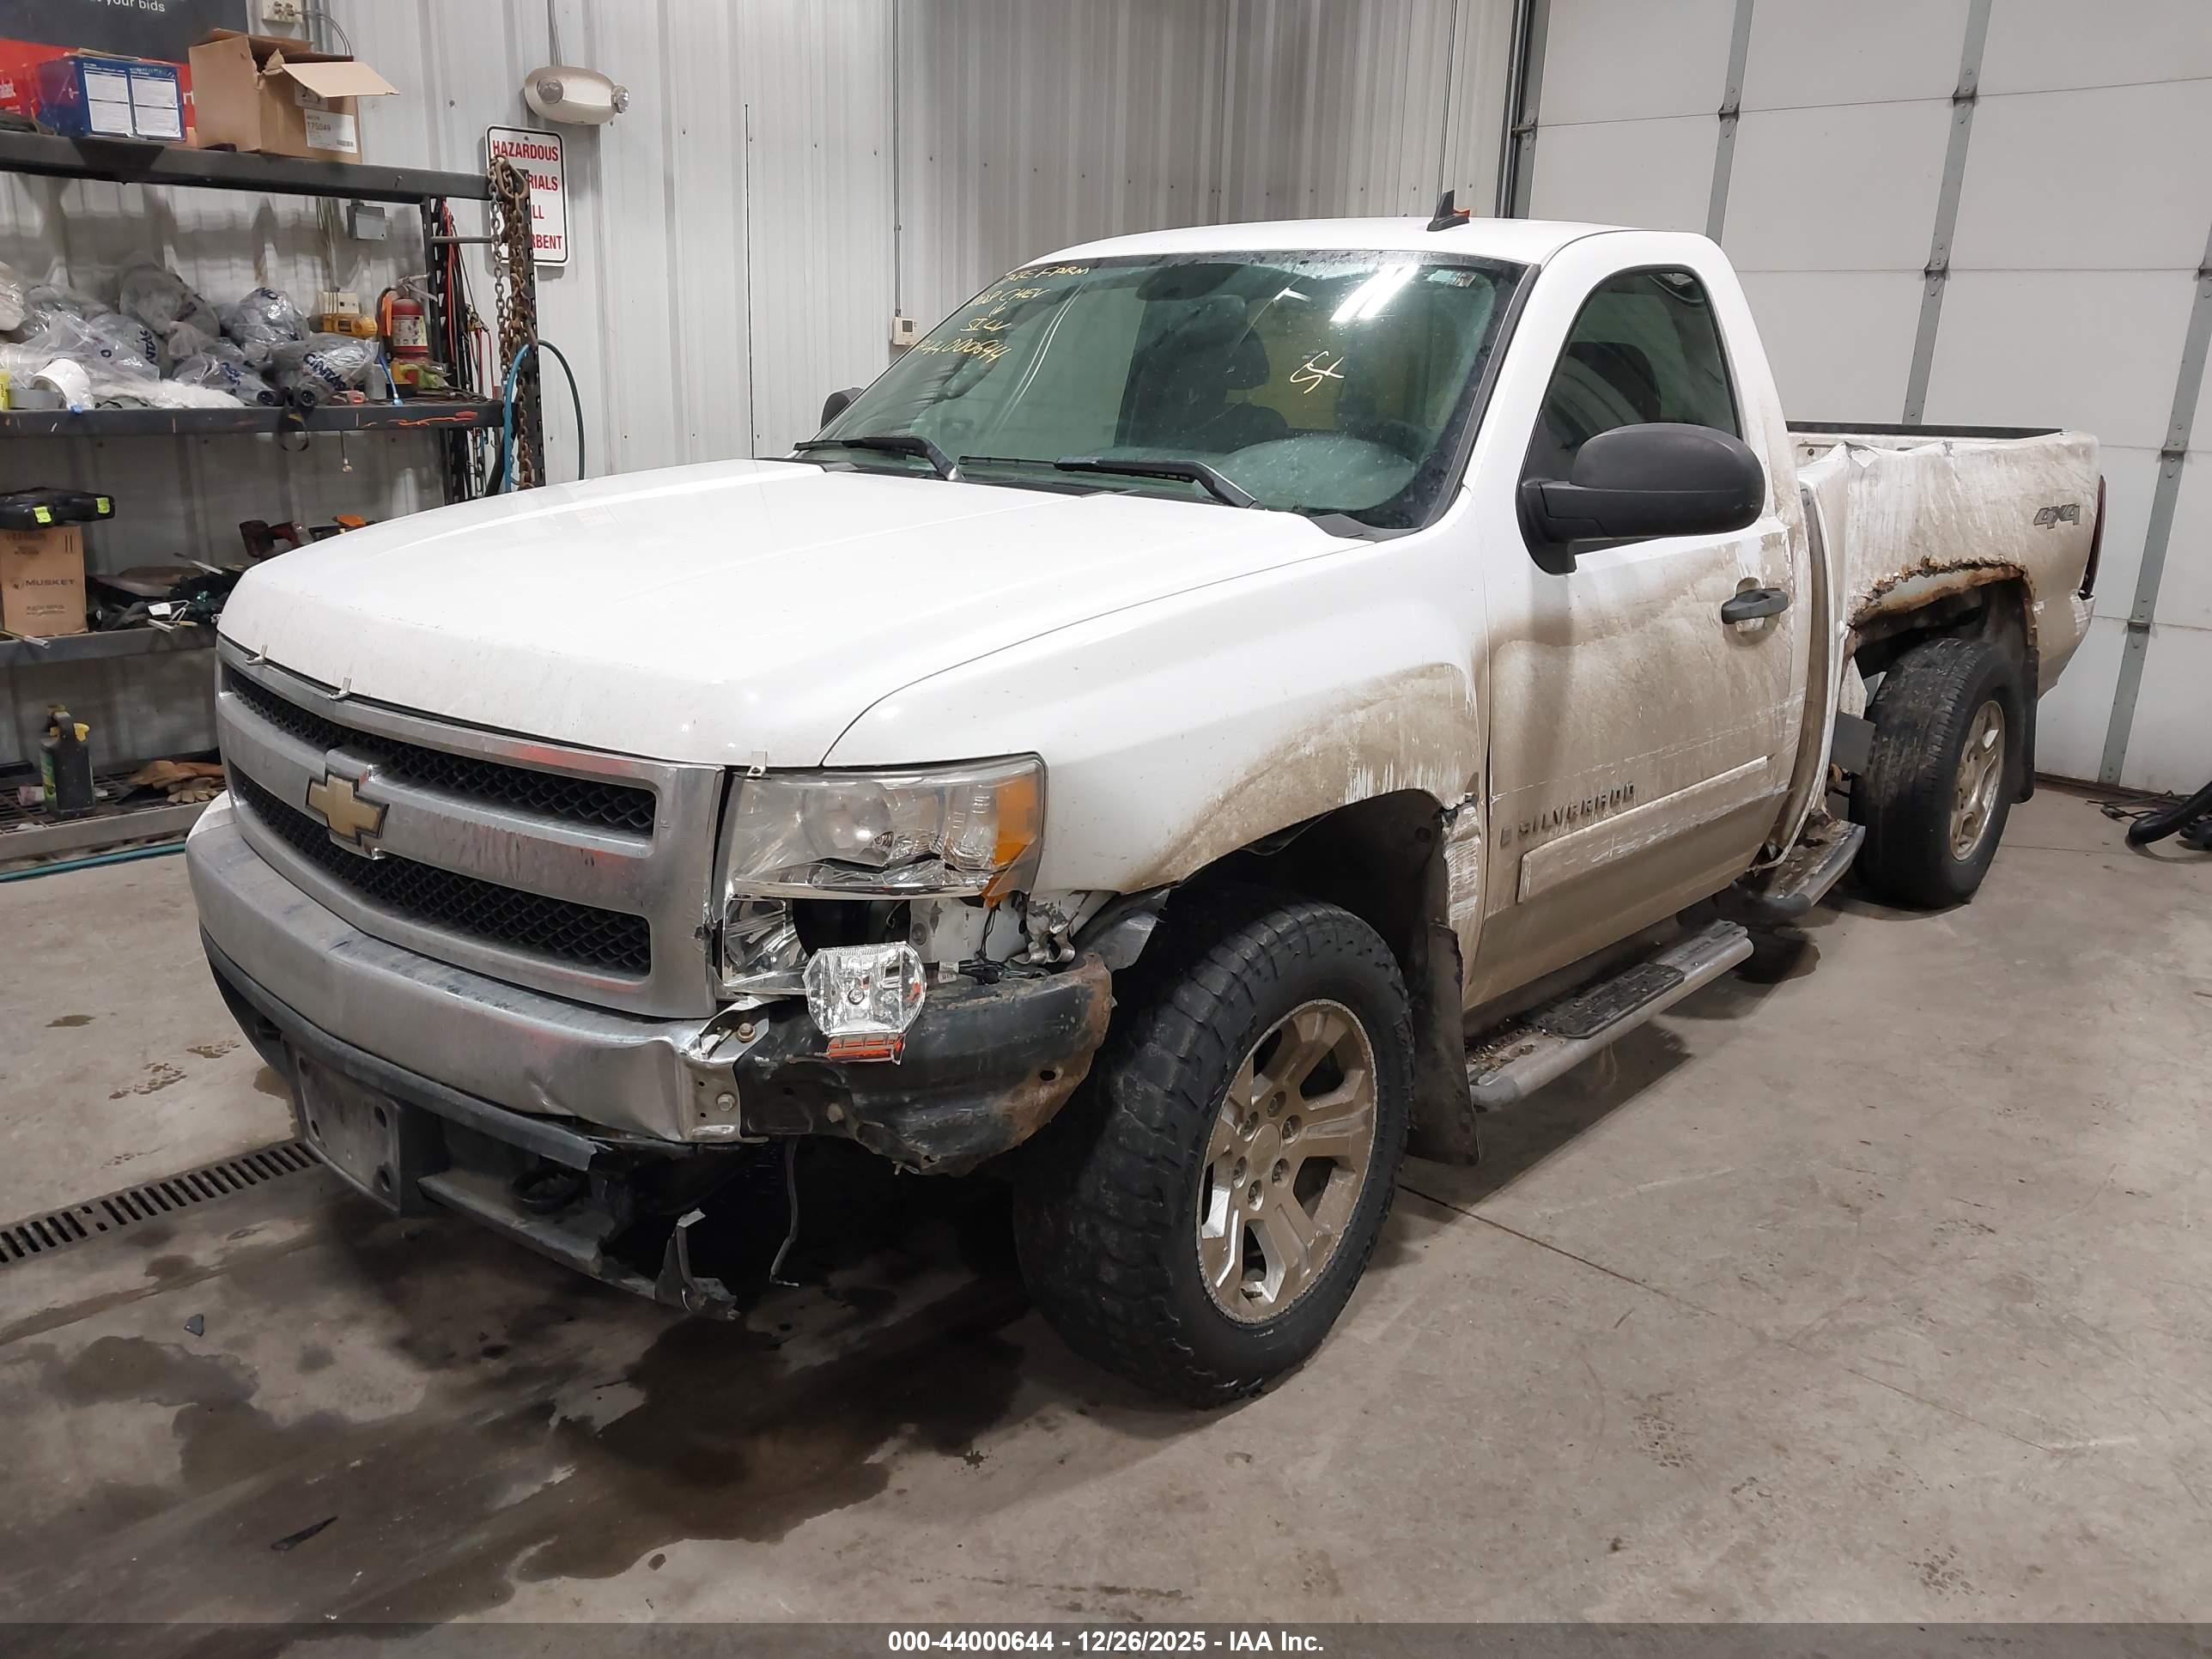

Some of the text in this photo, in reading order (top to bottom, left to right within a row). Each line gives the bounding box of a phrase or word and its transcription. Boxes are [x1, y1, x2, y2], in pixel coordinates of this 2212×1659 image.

[492, 140, 559, 161] HAZARDOUS
[528, 173, 558, 191] RIALS
[531, 234, 562, 250] RBENT
[1034, 266, 1091, 280] FARM
[25, 578, 76, 587] MUSKET
